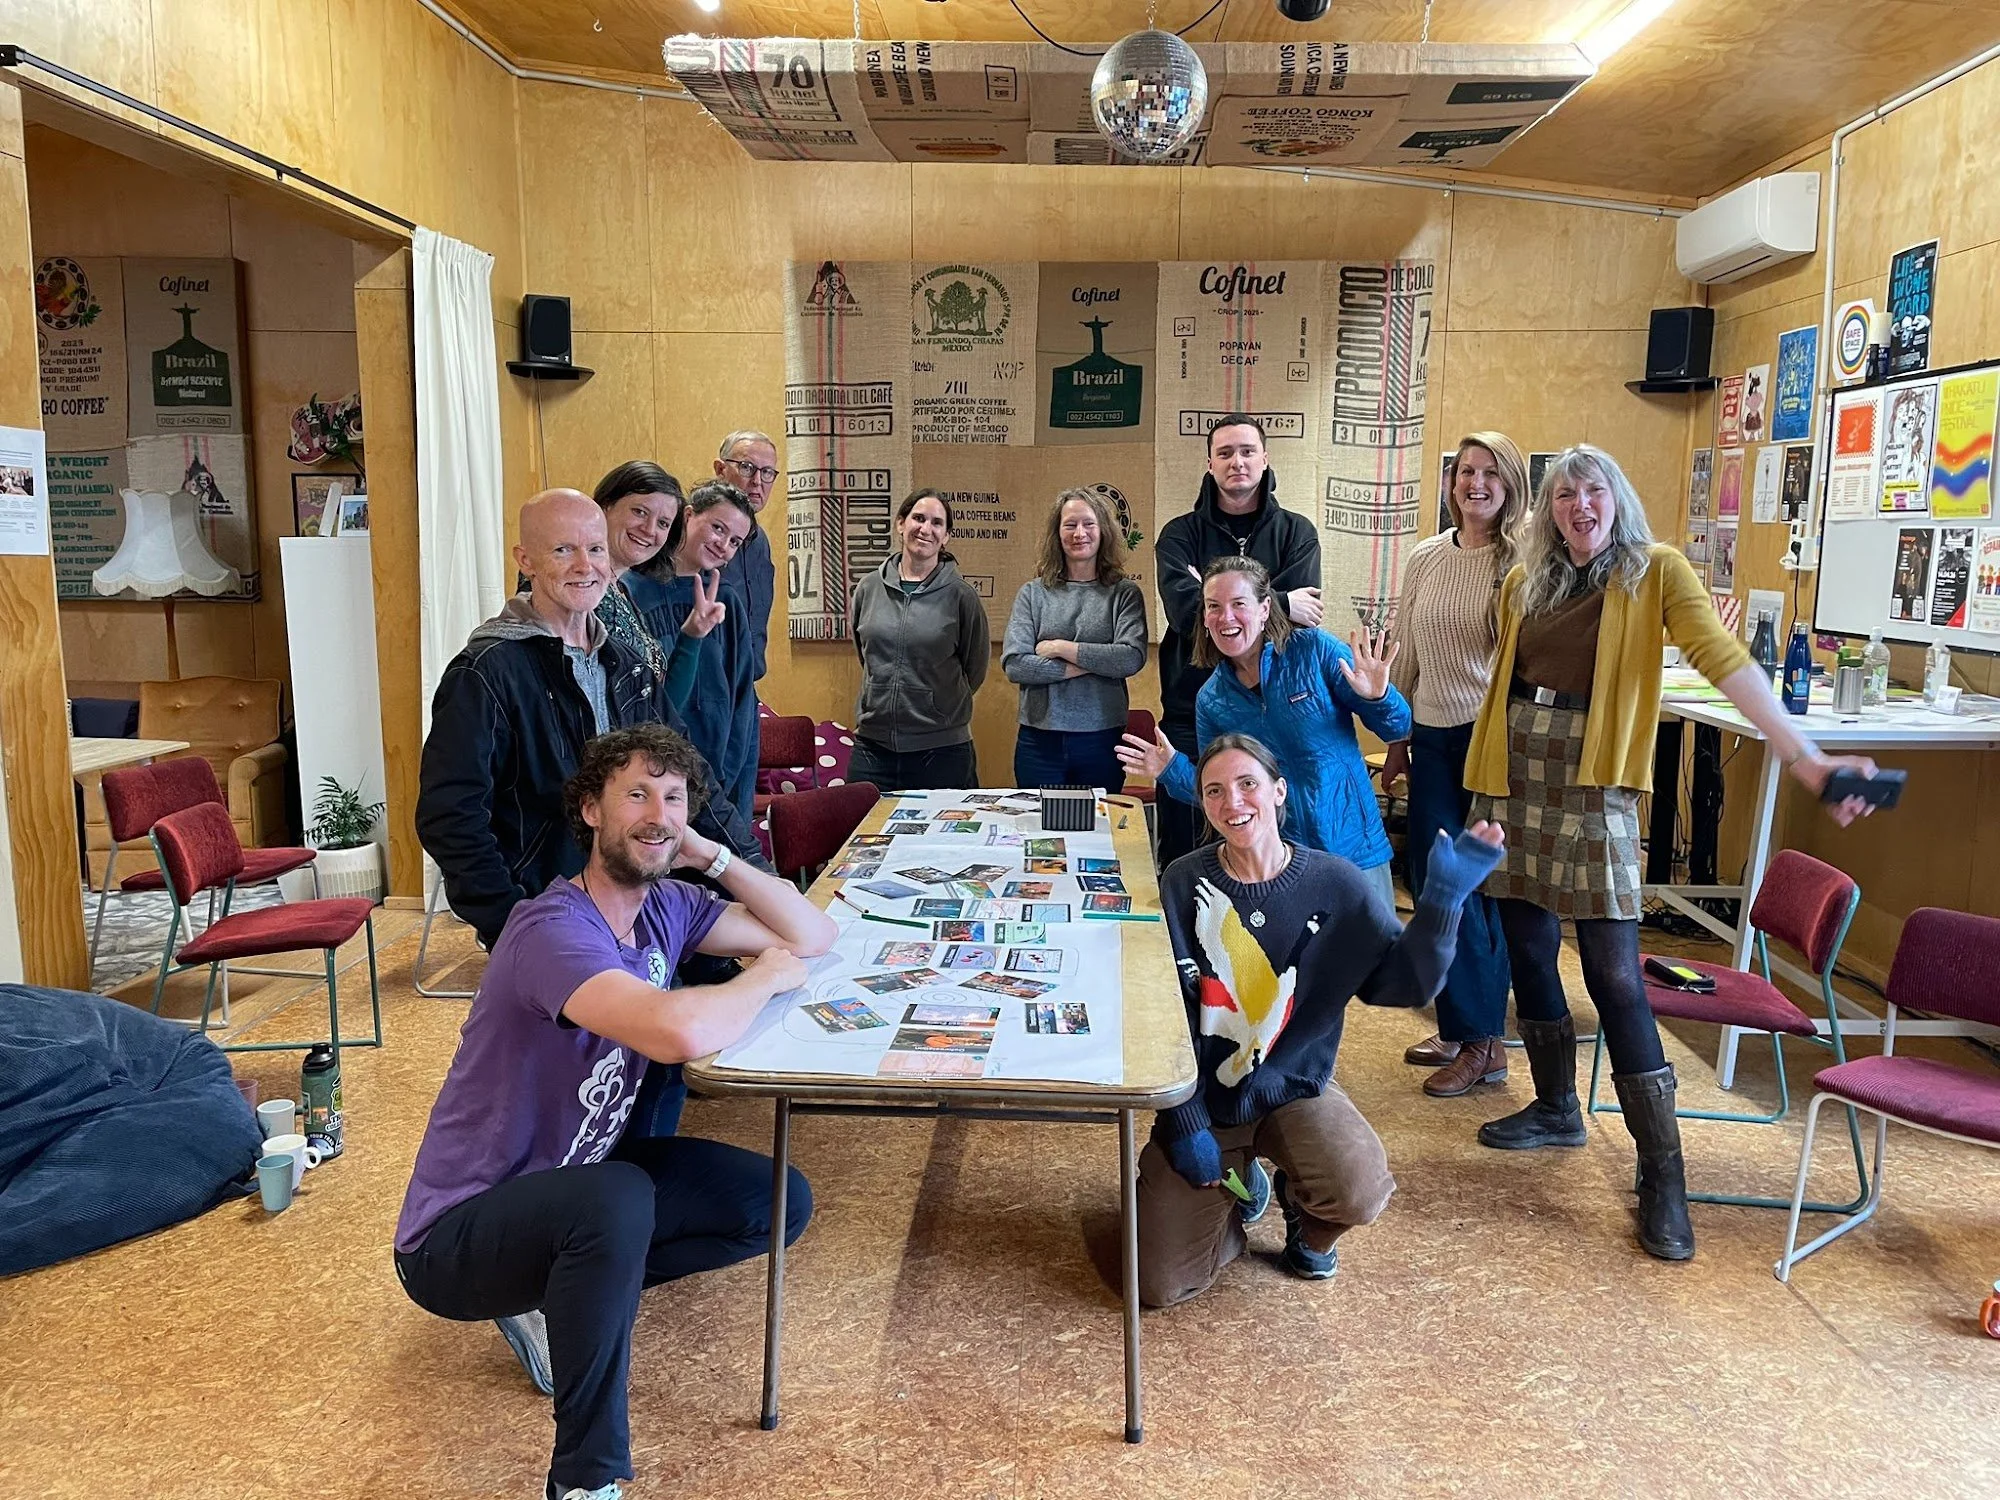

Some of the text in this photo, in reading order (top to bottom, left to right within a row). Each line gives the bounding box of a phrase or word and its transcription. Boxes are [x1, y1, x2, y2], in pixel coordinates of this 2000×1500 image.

[763, 53, 815, 89] 70
[1247, 107, 1374, 118] KONGO COFFEE
[1894, 253, 1916, 280] LIFE
[159, 275, 210, 296] Cofinet
[1200, 265, 1286, 303] Cofinet
[1391, 267, 1404, 292] DE
[1072, 287, 1121, 307] Cofinet
[1845, 328, 1862, 339] SAFE
[972, 337, 1004, 345] CHIAPAS
[1219, 341, 1262, 351] POPAYAN
[1845, 338, 1861, 348] SPACE
[165, 353, 216, 368] Brazil
[1221, 355, 1259, 366] DECAF
[1072, 368, 1124, 386] Brazil
[805, 389, 850, 405] NACIONAL
[853, 389, 869, 404] DEL
[871, 386, 893, 404] CAFÉ
[913, 397, 1008, 406] ORGANIC GREEN COFFEE
[61, 396, 105, 415] COFFEE
[912, 406, 956, 416] RTIFICADO
[957, 407, 975, 415] POR
[957, 424, 971, 433] OF
[973, 424, 1009, 433] MEXICO
[1186, 417, 1193, 429] 3
[922, 433, 950, 443] KILOS
[951, 434, 970, 443] NET
[970, 433, 1007, 443] WEIGHT
[1340, 425, 1348, 441] 3
[59, 456, 109, 467] WEIGHT
[956, 492, 973, 503] NEW
[974, 492, 1000, 504] GUINEA
[966, 510, 992, 521] COFFEE
[993, 511, 1017, 522] BEANS
[1351, 514, 1366, 528] DEL
[1368, 512, 1415, 531] NACIONAL
[951, 528, 1008, 540] SOUND AND NEW
[788, 554, 818, 600] 70
